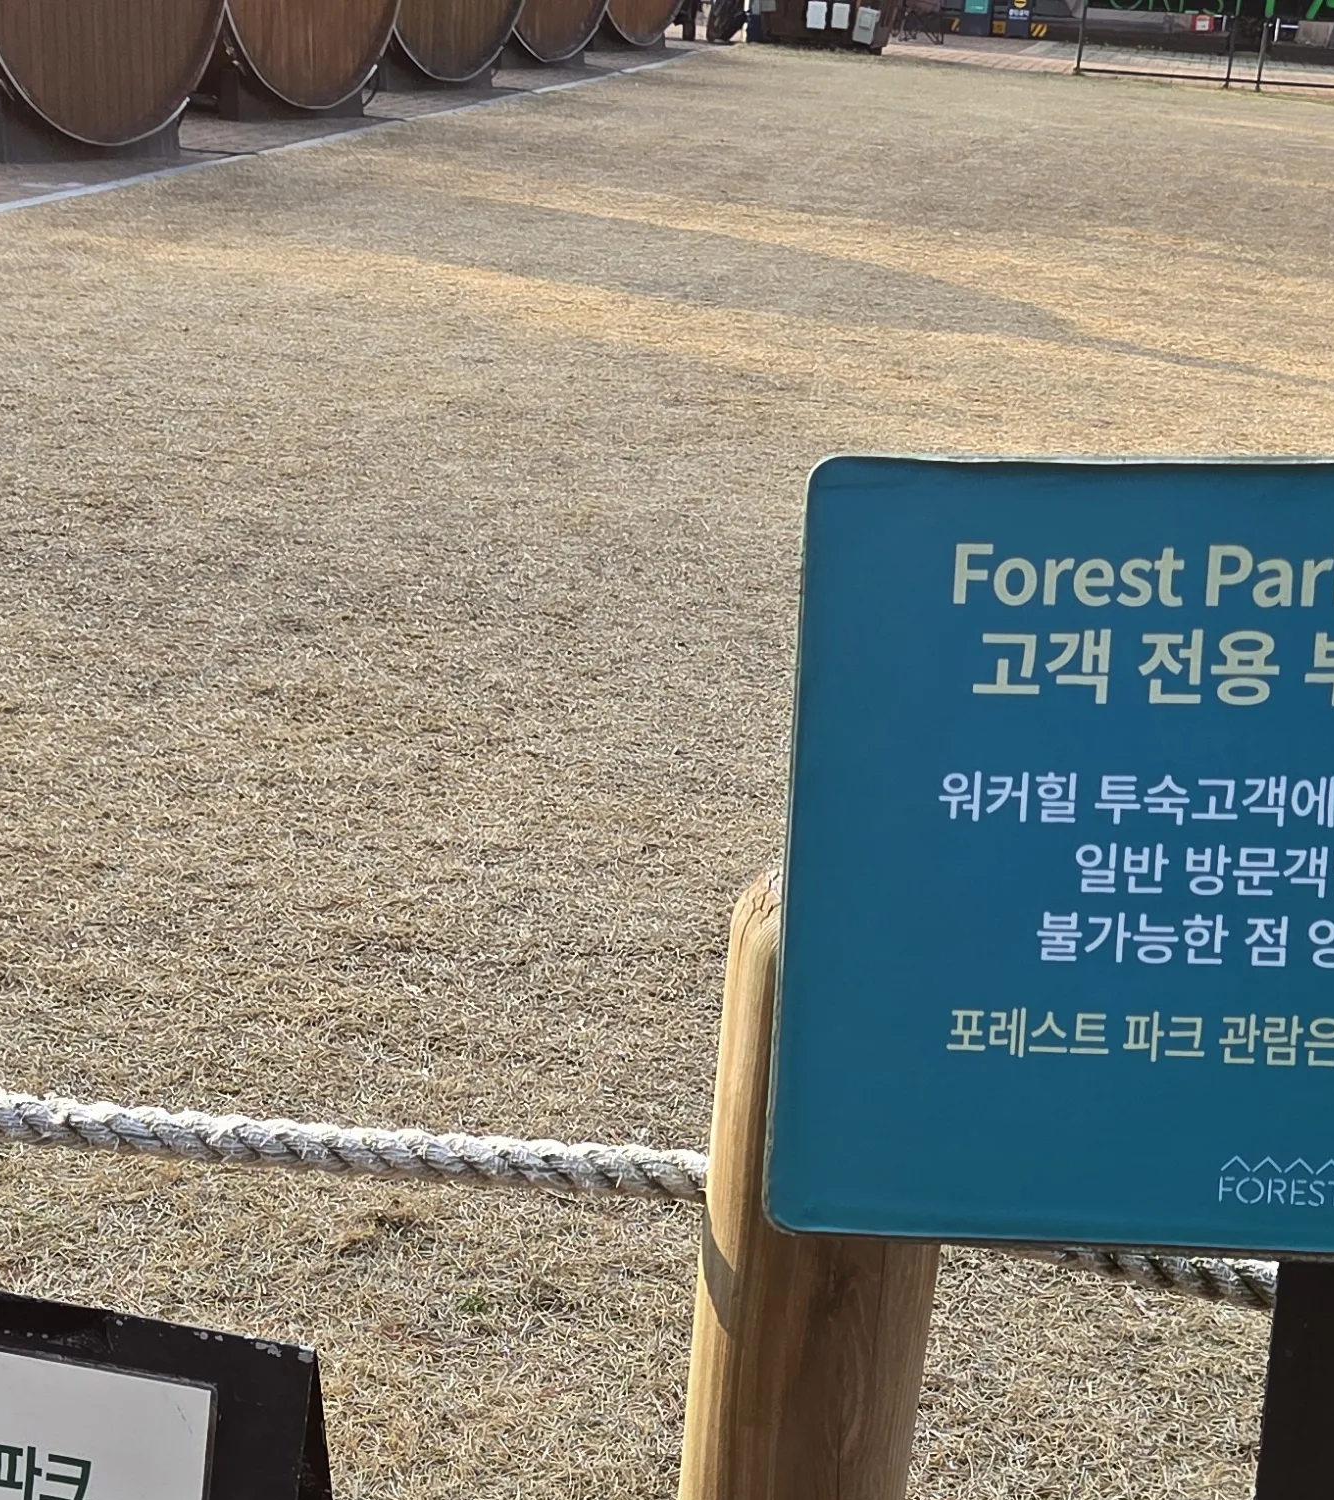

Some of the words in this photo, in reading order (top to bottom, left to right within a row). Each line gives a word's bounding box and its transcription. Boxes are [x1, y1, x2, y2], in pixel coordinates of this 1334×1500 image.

[952, 543, 1185, 607] Forest
[972, 628, 1112, 705] 고객
[1138, 628, 1280, 706] 전용
[938, 770, 1077, 823] 워커힐
[1075, 842, 1170, 894] 일반
[1036, 911, 1230, 965] 불가능한
[1244, 916, 1289, 967] 점
[946, 1007, 1109, 1058] 포레스트
[1122, 1011, 1205, 1063] 파크
